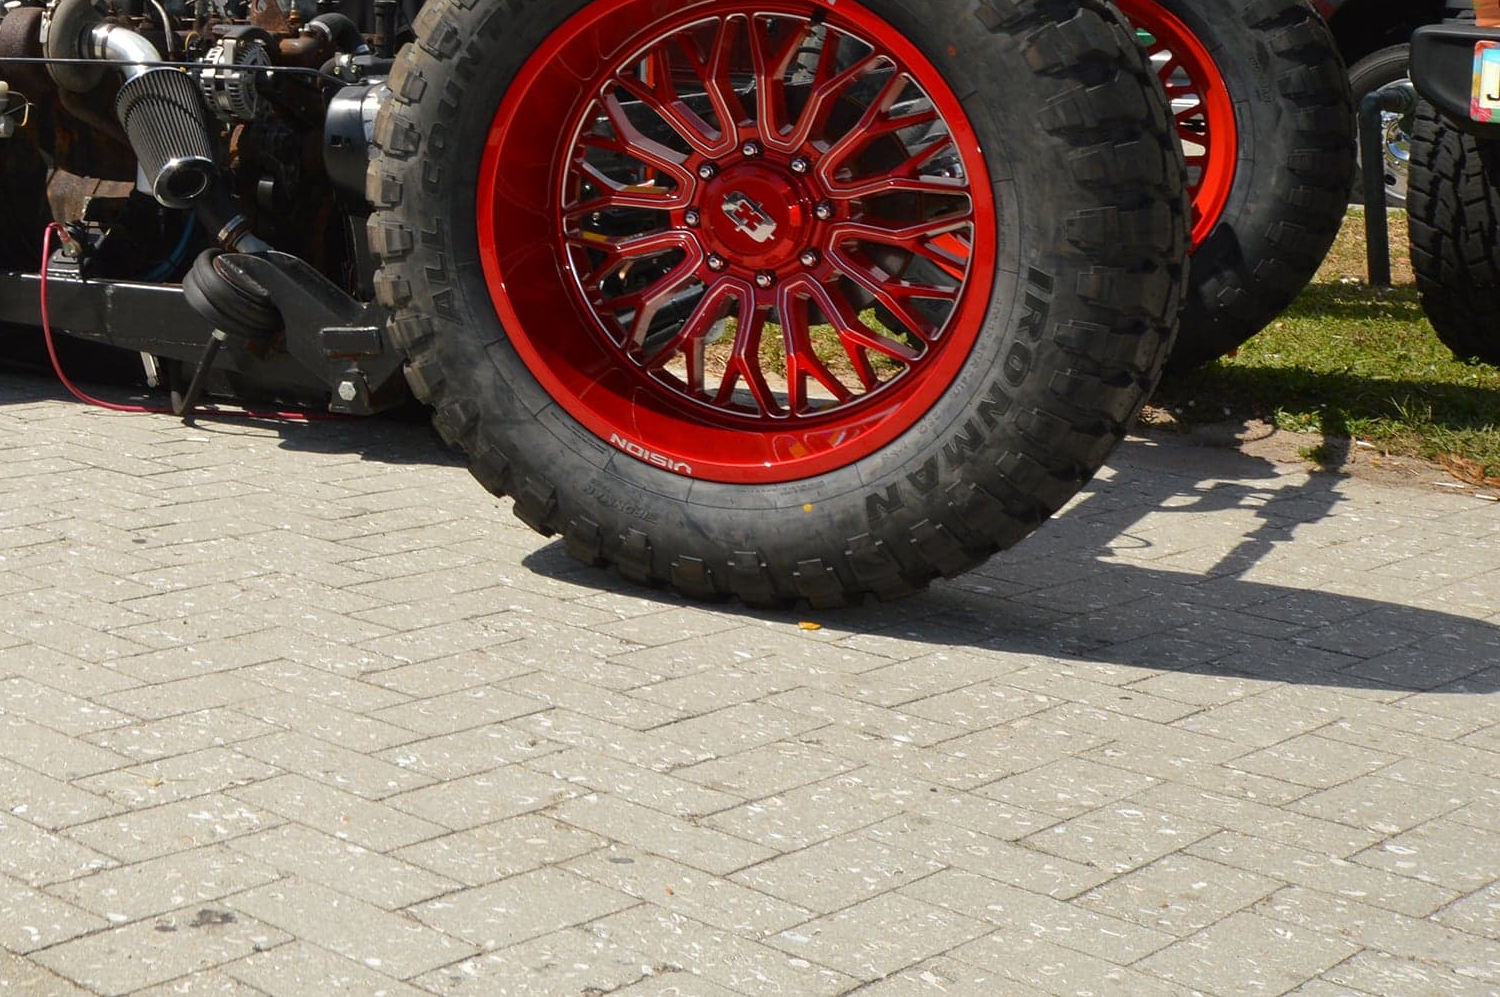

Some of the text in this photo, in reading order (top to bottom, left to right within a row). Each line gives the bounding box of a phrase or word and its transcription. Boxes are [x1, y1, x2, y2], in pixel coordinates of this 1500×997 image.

[421, 216, 464, 326] ALL
[863, 265, 1055, 522] IRONMAN
[609, 433, 693, 475] VISION
